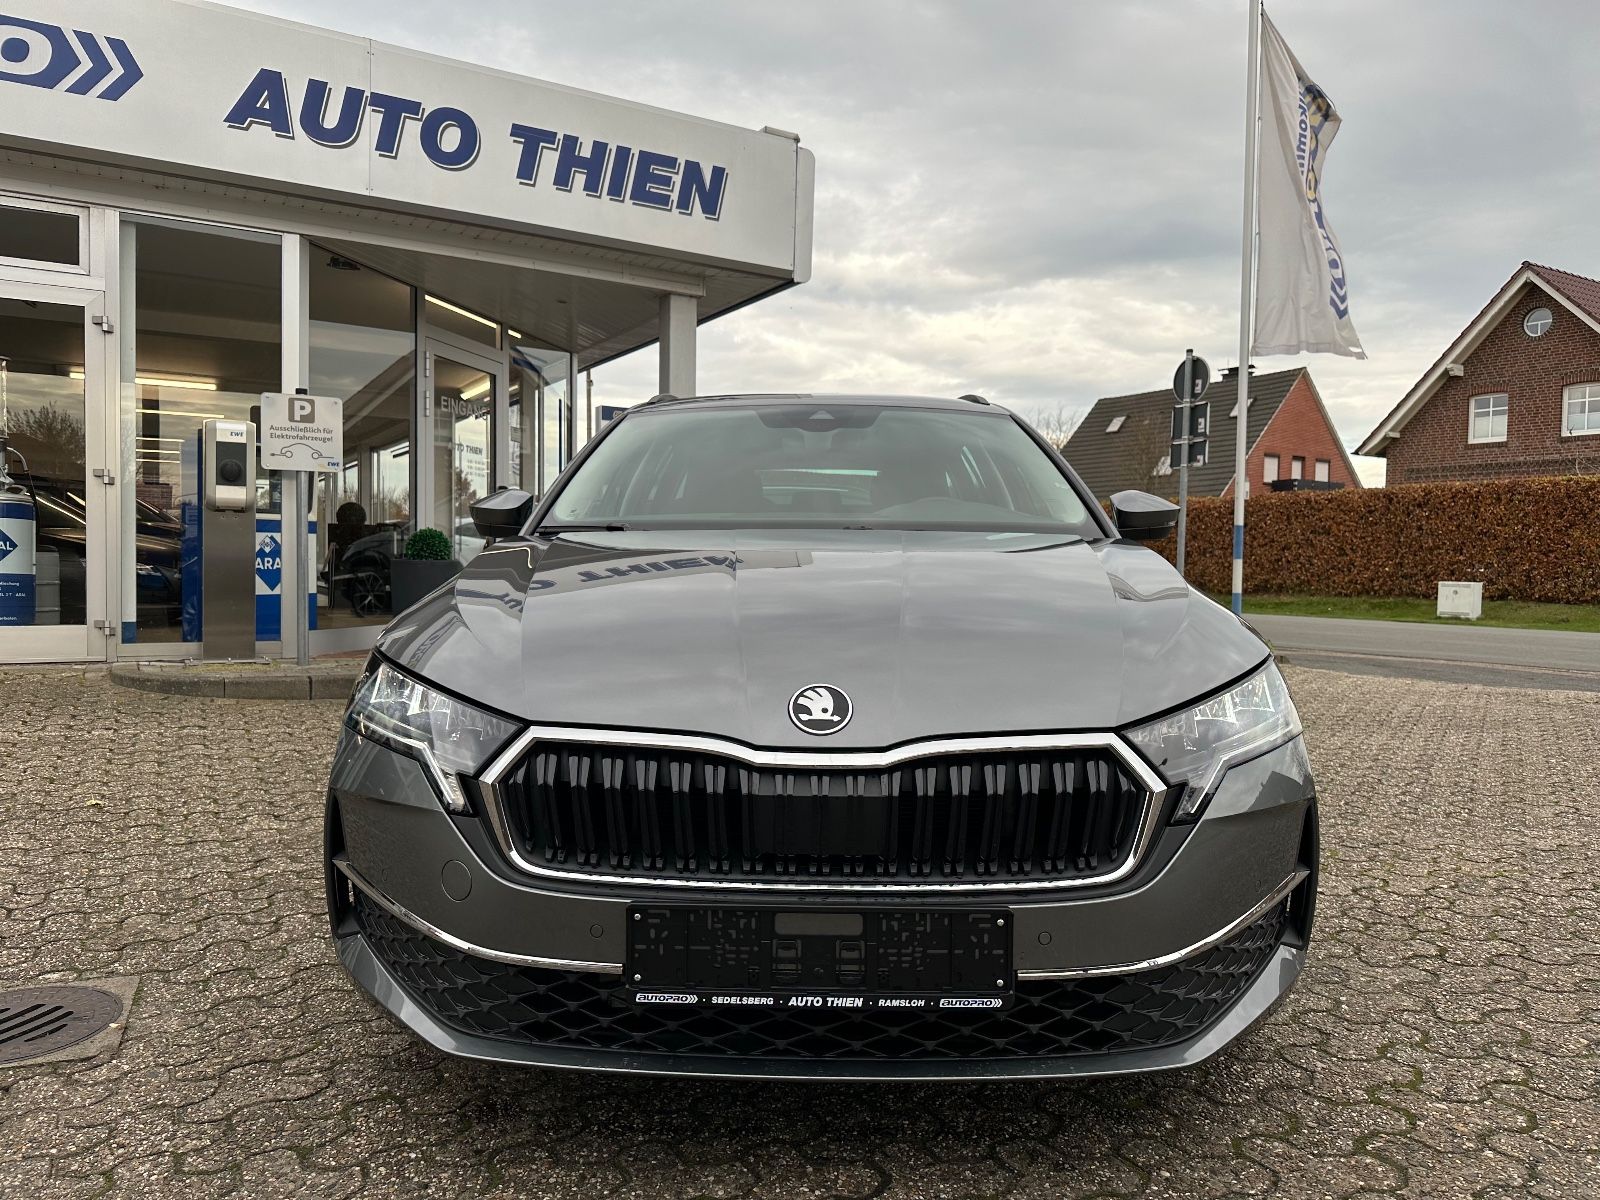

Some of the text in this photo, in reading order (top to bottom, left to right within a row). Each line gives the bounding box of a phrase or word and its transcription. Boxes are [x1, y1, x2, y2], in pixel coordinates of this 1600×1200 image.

[222, 68, 729, 221] AUTO THIEN
[293, 400, 312, 421] P
[269, 425, 334, 435] Ausschließlich für
[269, 433, 333, 443] Elektrofahrzeuge!
[711, 996, 774, 1005] SEDELSBERG
[788, 996, 823, 1007] AUTO
[826, 997, 864, 1008] THIEN
[878, 999, 926, 1007] RAMSLOH
